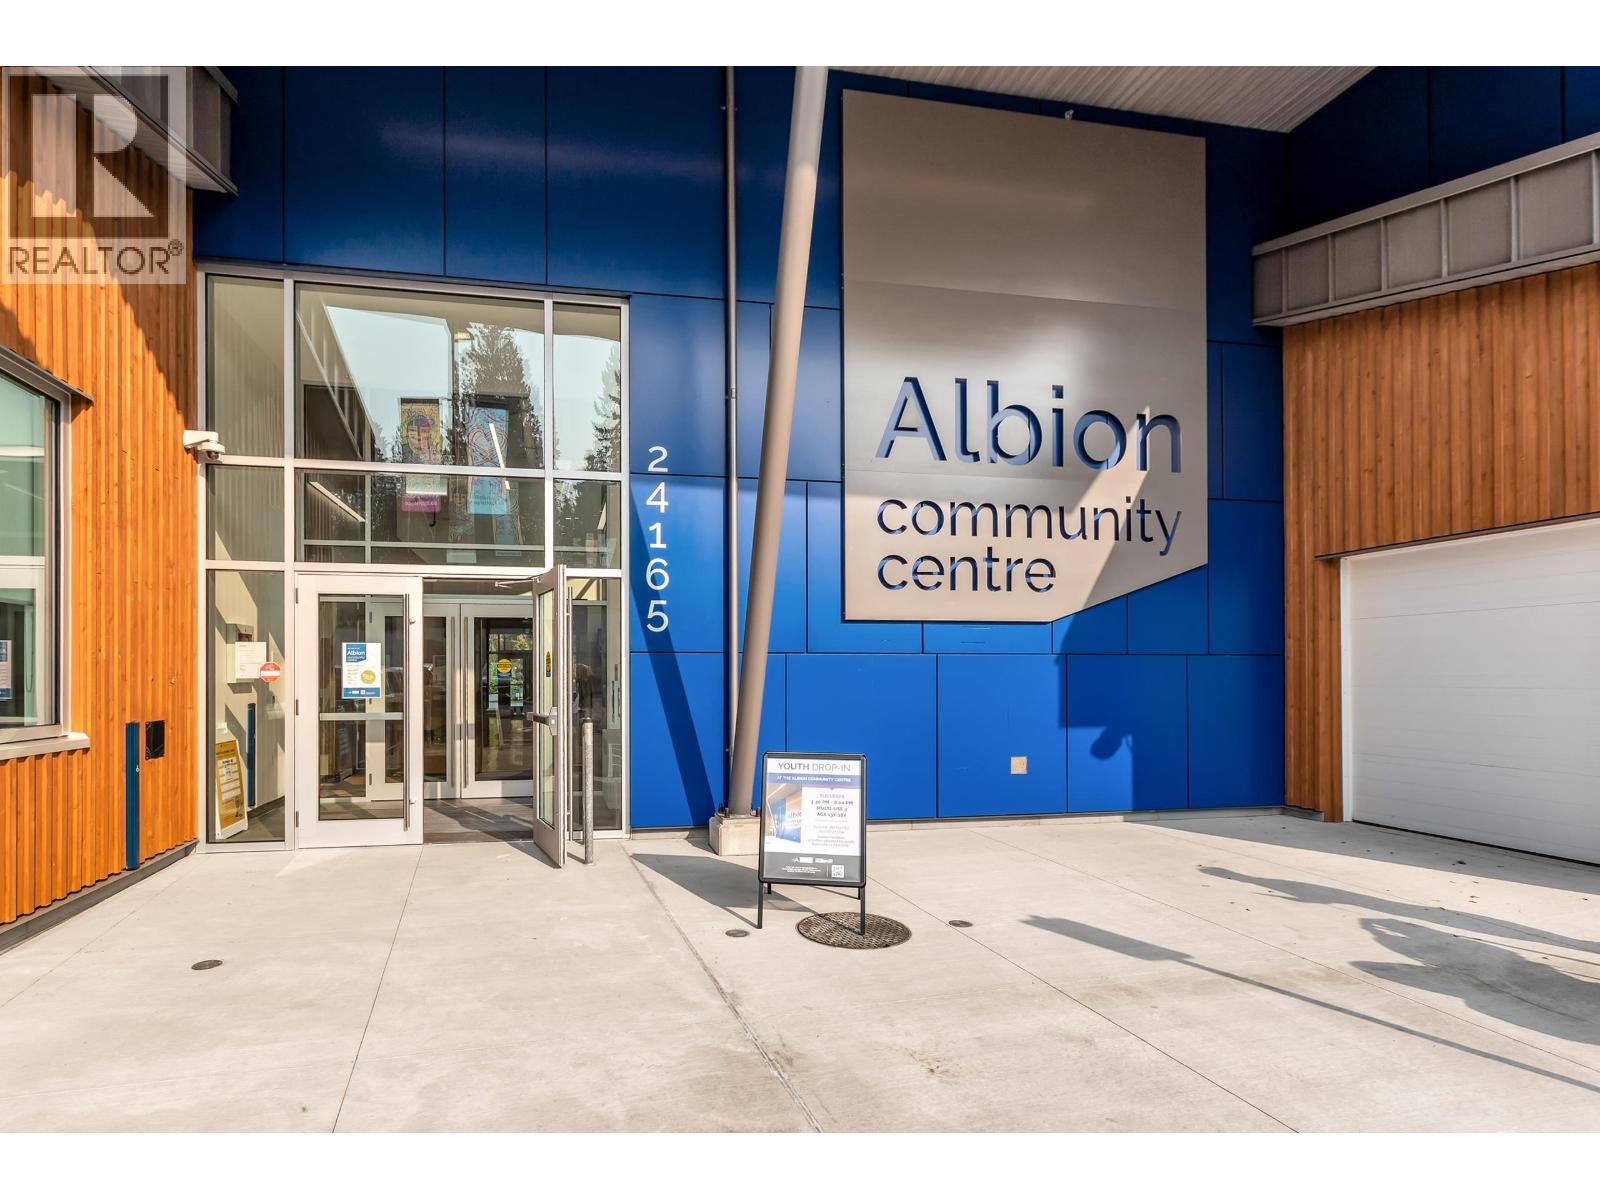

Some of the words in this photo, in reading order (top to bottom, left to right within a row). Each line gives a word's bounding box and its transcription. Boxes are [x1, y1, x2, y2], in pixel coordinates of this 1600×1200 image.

[875, 377, 1181, 473] Albion
[645, 446, 670, 632] 24165
[877, 496, 1181, 557] community
[877, 547, 1056, 593] centre
[778, 762, 810, 771] YOUTH
[812, 764, 851, 772] DROP-IN
